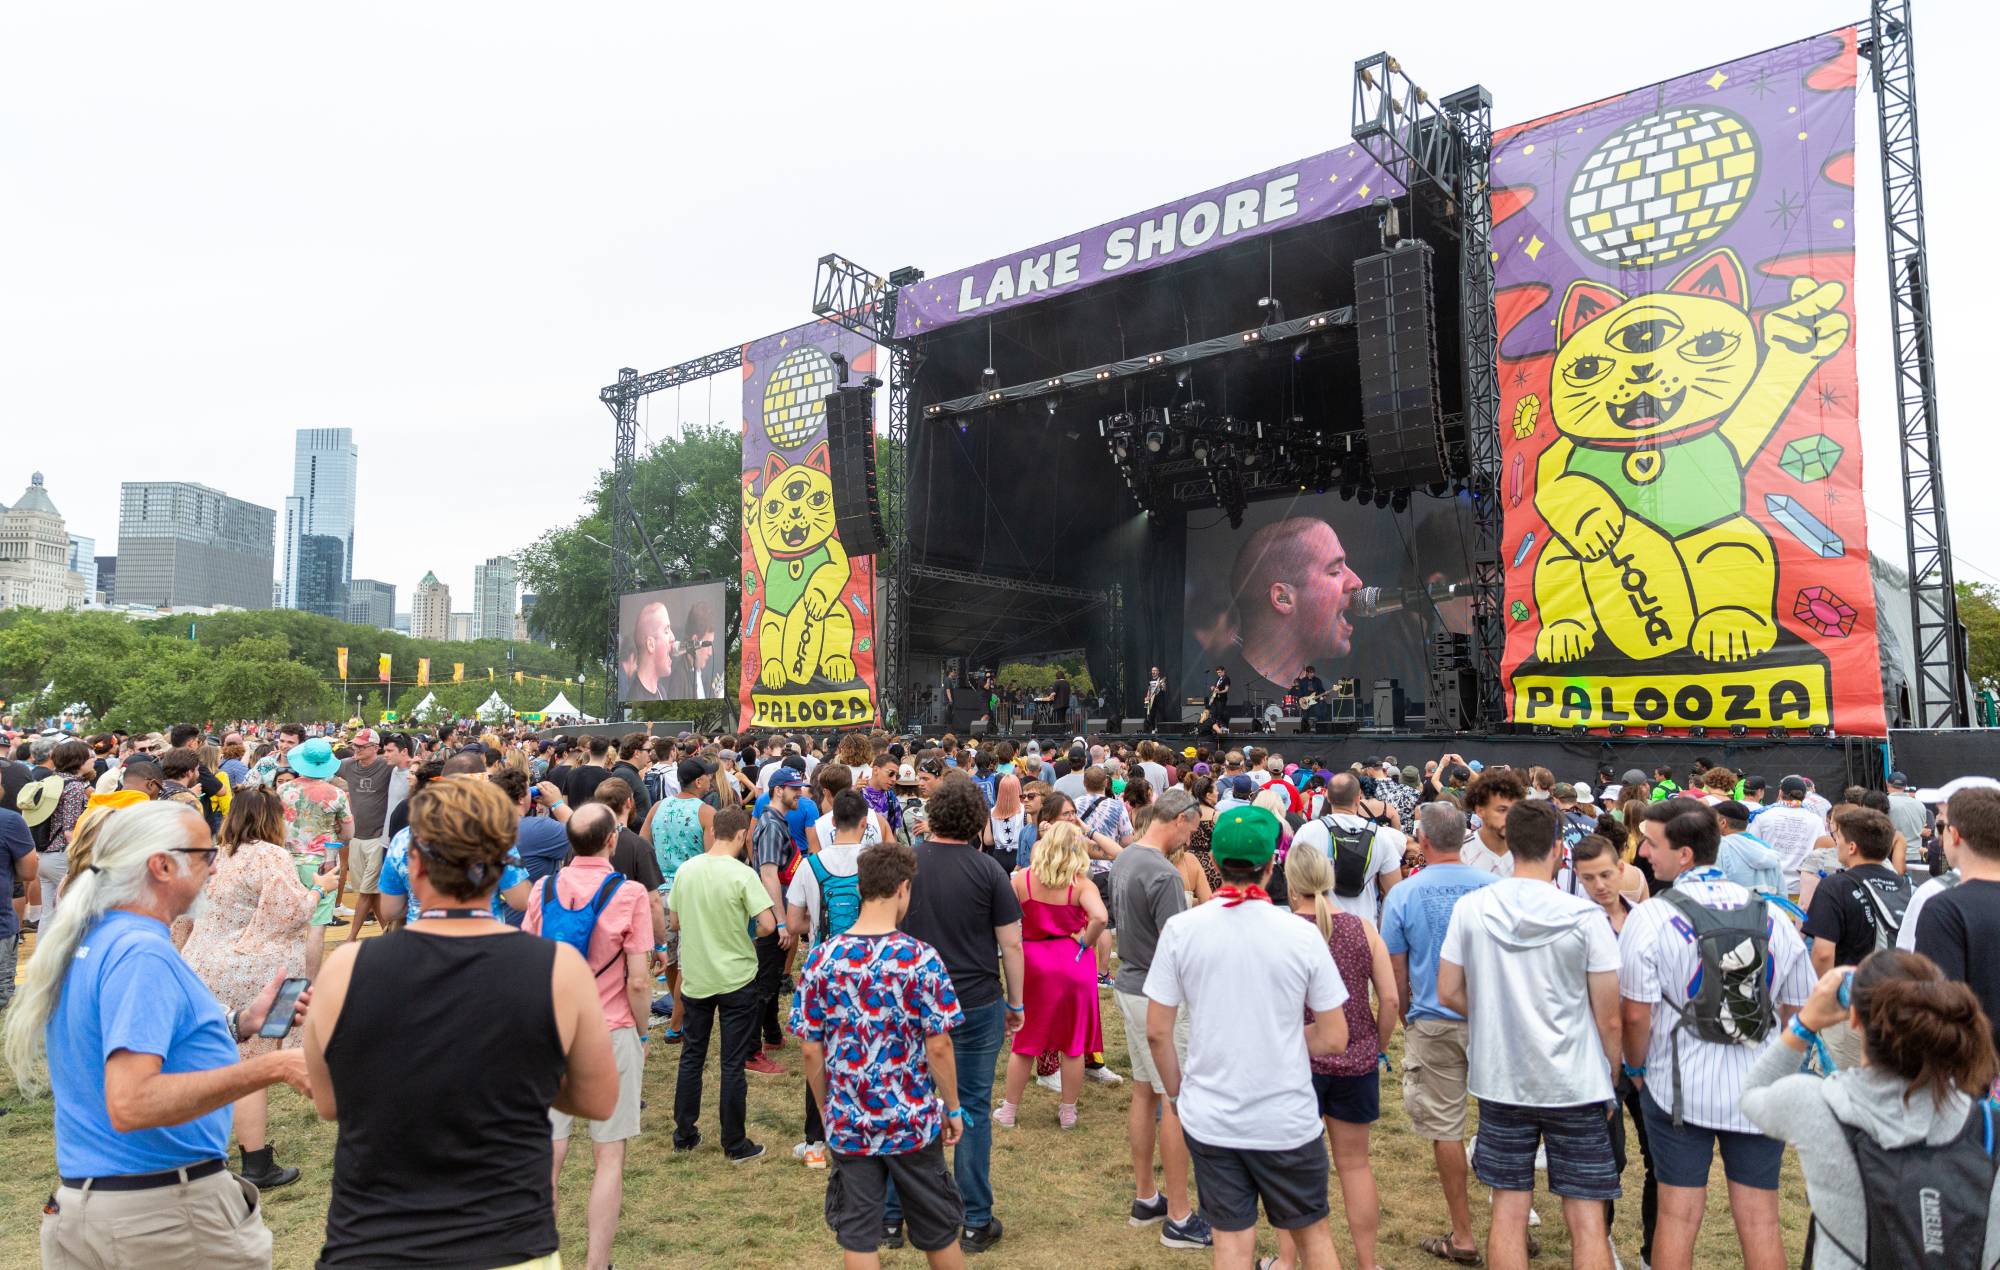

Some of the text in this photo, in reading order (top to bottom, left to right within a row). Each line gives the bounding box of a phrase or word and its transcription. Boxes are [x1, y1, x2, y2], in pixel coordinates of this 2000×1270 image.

[957, 172, 1300, 314] LAKE SHORE
[1609, 548, 1673, 646] LOLLA
[757, 697, 867, 723] PALOOZA
[1526, 679, 1811, 721] PALOOZA
[1919, 1187, 1944, 1254] CAMELBAK
